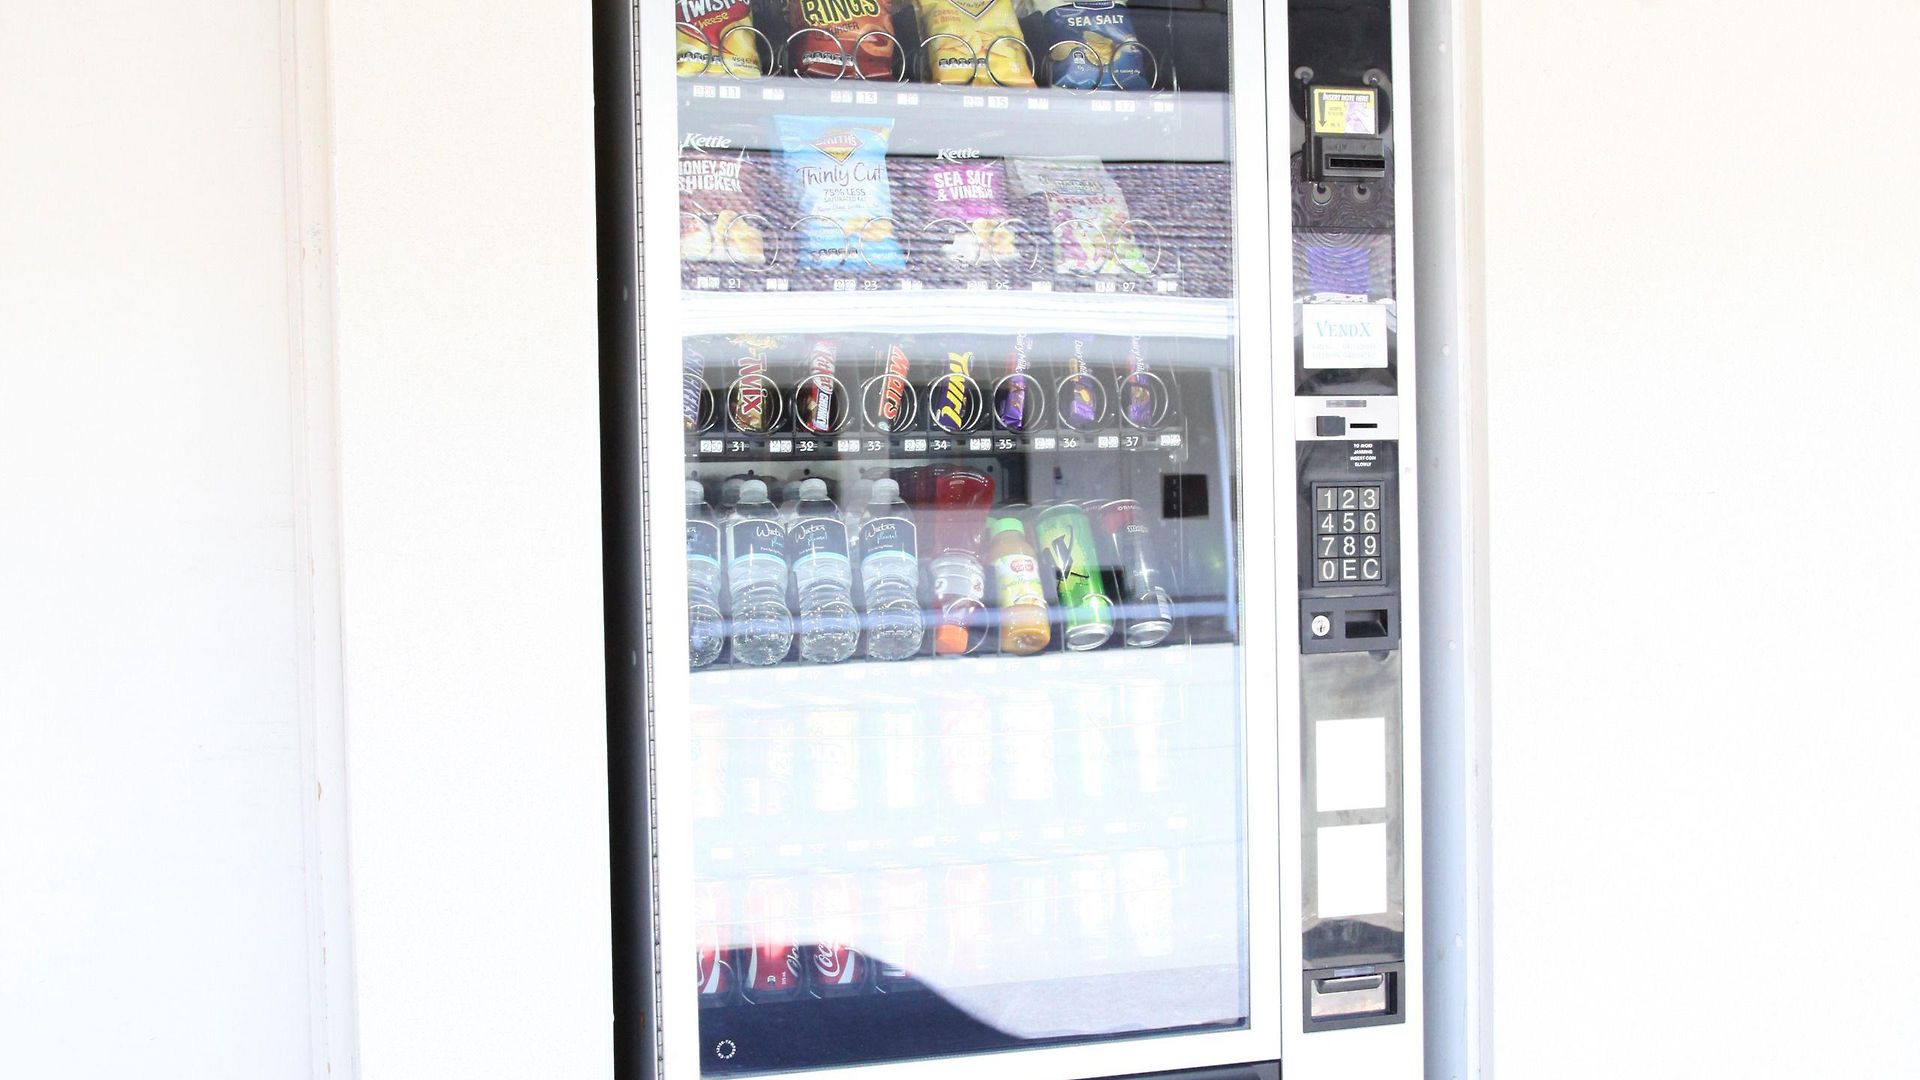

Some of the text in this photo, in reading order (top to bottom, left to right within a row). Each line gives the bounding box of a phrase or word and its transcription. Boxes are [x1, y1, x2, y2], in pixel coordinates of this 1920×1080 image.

[800, 0, 881, 27] RINGS
[1067, 14, 1124, 27] SEA SALT
[863, 92, 875, 103] 13
[682, 132, 732, 151] Kettle
[936, 148, 980, 162] Kettle
[719, 160, 740, 179] SOY
[795, 162, 885, 188] Thinly Cut
[933, 169, 994, 189] SEA SALT
[934, 188, 949, 202] &
[731, 441, 745, 452] 31
[799, 441, 814, 452] 32
[867, 440, 881, 451] 33
[933, 440, 947, 450] 34
[999, 439, 1013, 450] 35
[1063, 437, 1077, 448] 36
[1125, 436, 1139, 447] 37
[1323, 489, 1376, 509] 1 2 3
[1321, 512, 1376, 533] 4 5 6
[1322, 535, 1376, 556] 7 8 9
[1322, 558, 1379, 580] 0 E C
